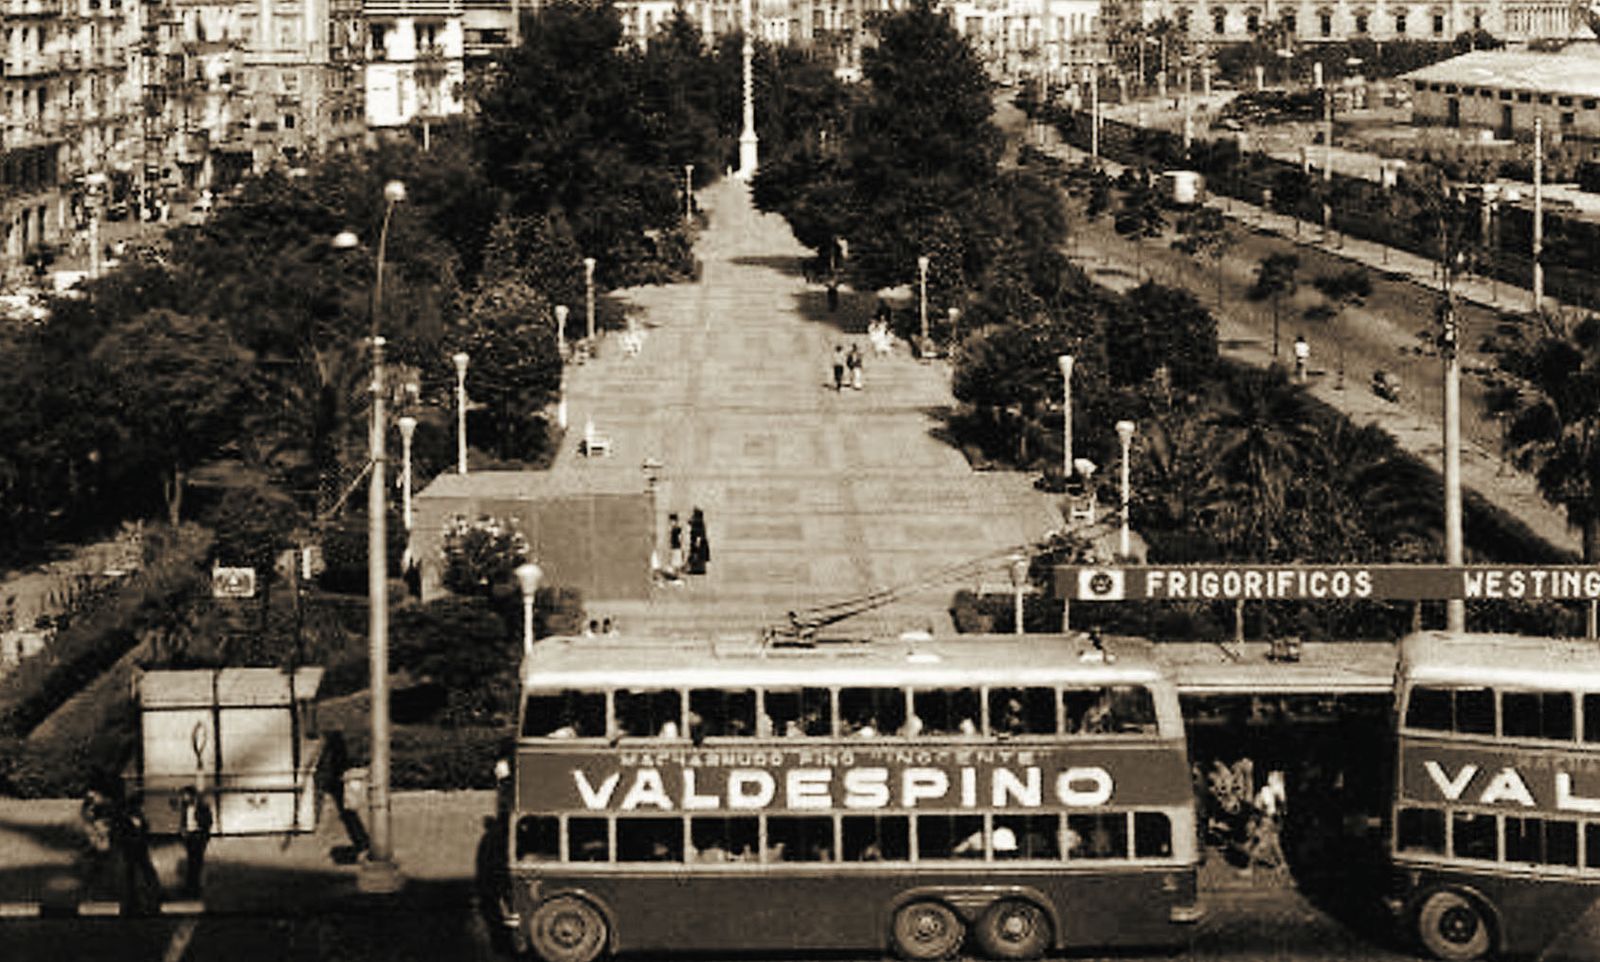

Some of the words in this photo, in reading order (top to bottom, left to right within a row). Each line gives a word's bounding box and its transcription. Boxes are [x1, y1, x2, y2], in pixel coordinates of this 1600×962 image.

[1146, 571, 1373, 598] FRIGORIFICOS
[1463, 570, 1600, 598] WESTING
[573, 766, 1113, 811] VALDESPINO
[1424, 761, 1600, 812] VAL
